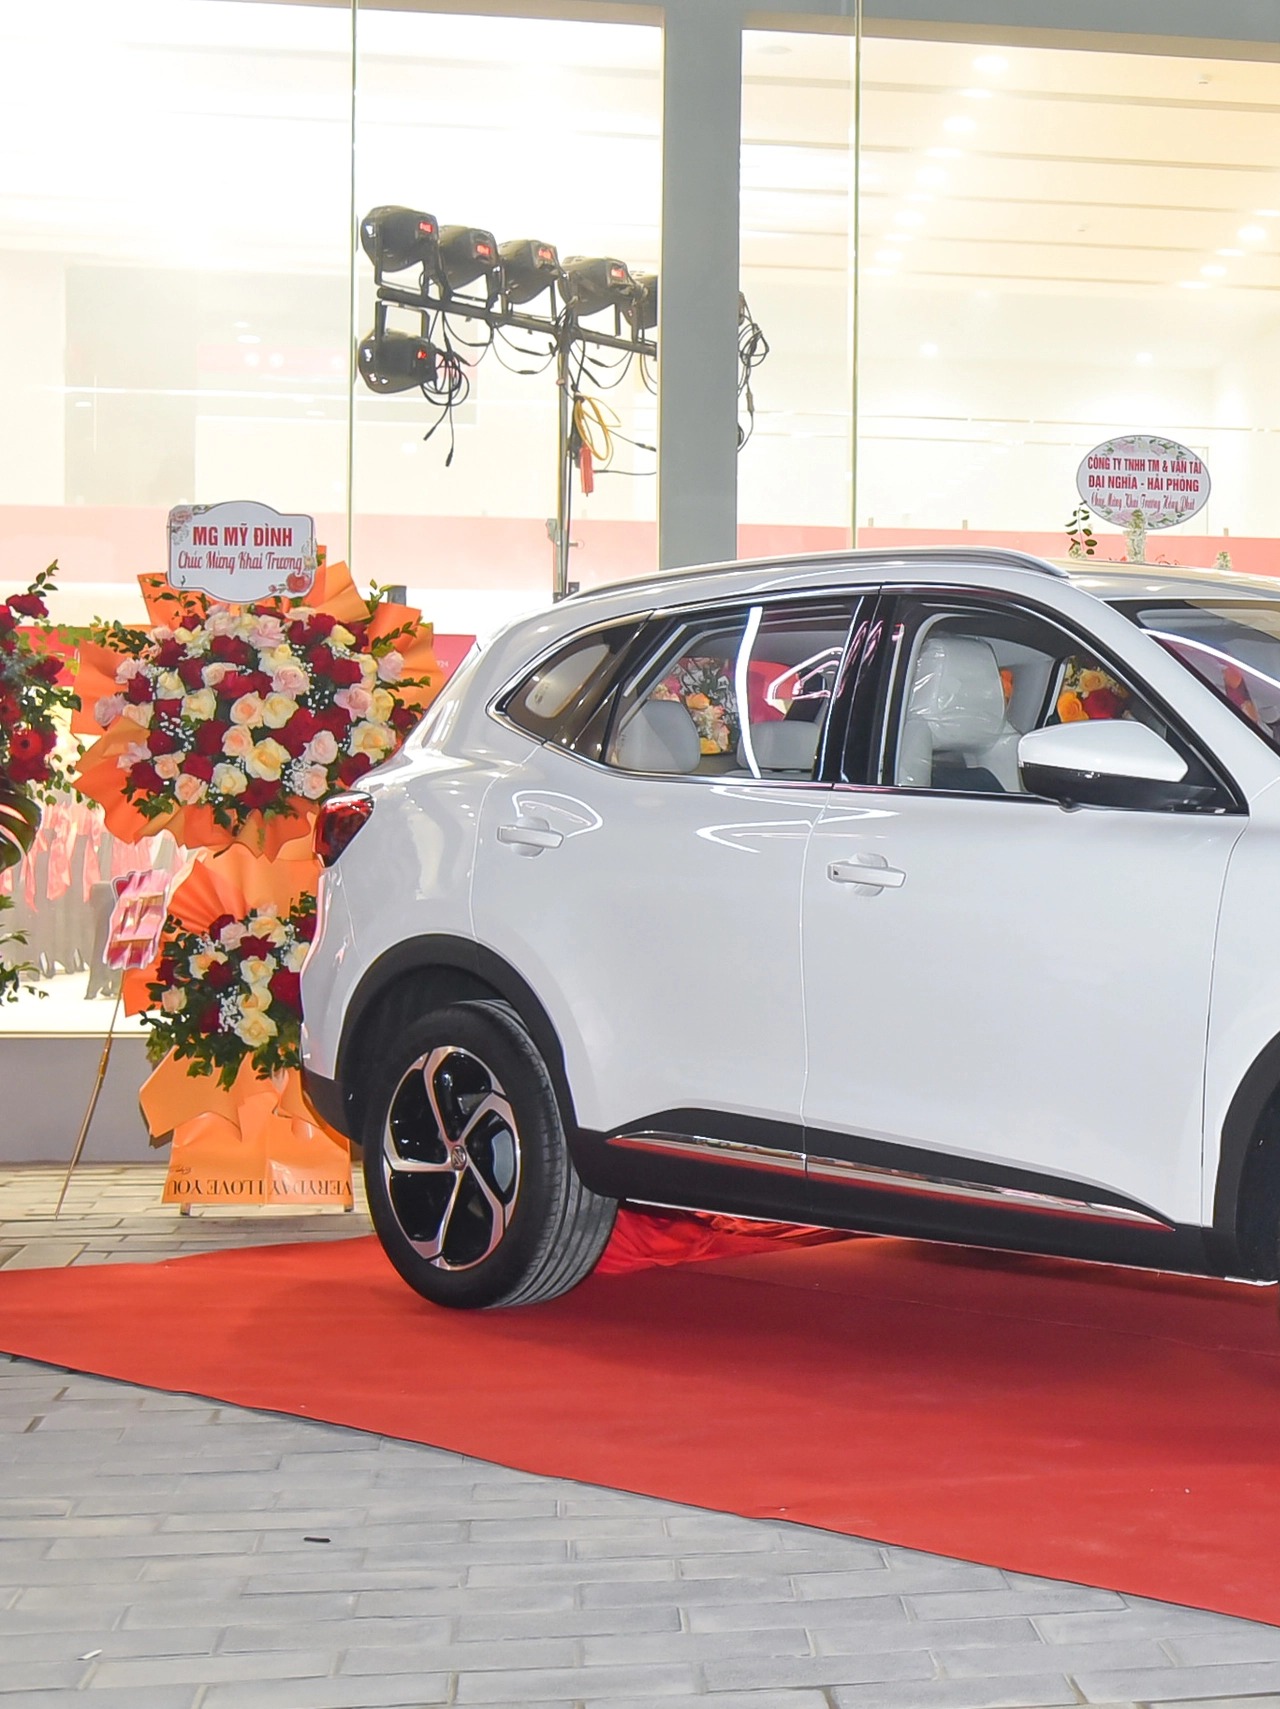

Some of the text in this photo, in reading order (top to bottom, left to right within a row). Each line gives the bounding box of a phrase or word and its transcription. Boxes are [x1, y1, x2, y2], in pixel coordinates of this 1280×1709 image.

[1088, 454, 1110, 470] CÔNG
[1113, 458, 1122, 471] TY
[1125, 458, 1145, 472] TNHH
[1148, 459, 1160, 473] TM
[1163, 461, 1168, 473] &
[1089, 475, 1105, 491] ĐẠI
[1108, 474, 1138, 490] NGHĨA
[193, 523, 292, 547] MG MỸ ĐÌNH
[238, 551, 262, 570] Khai
[167, 1180, 201, 1196] YOU
[207, 1180, 255, 1196] LOVE
